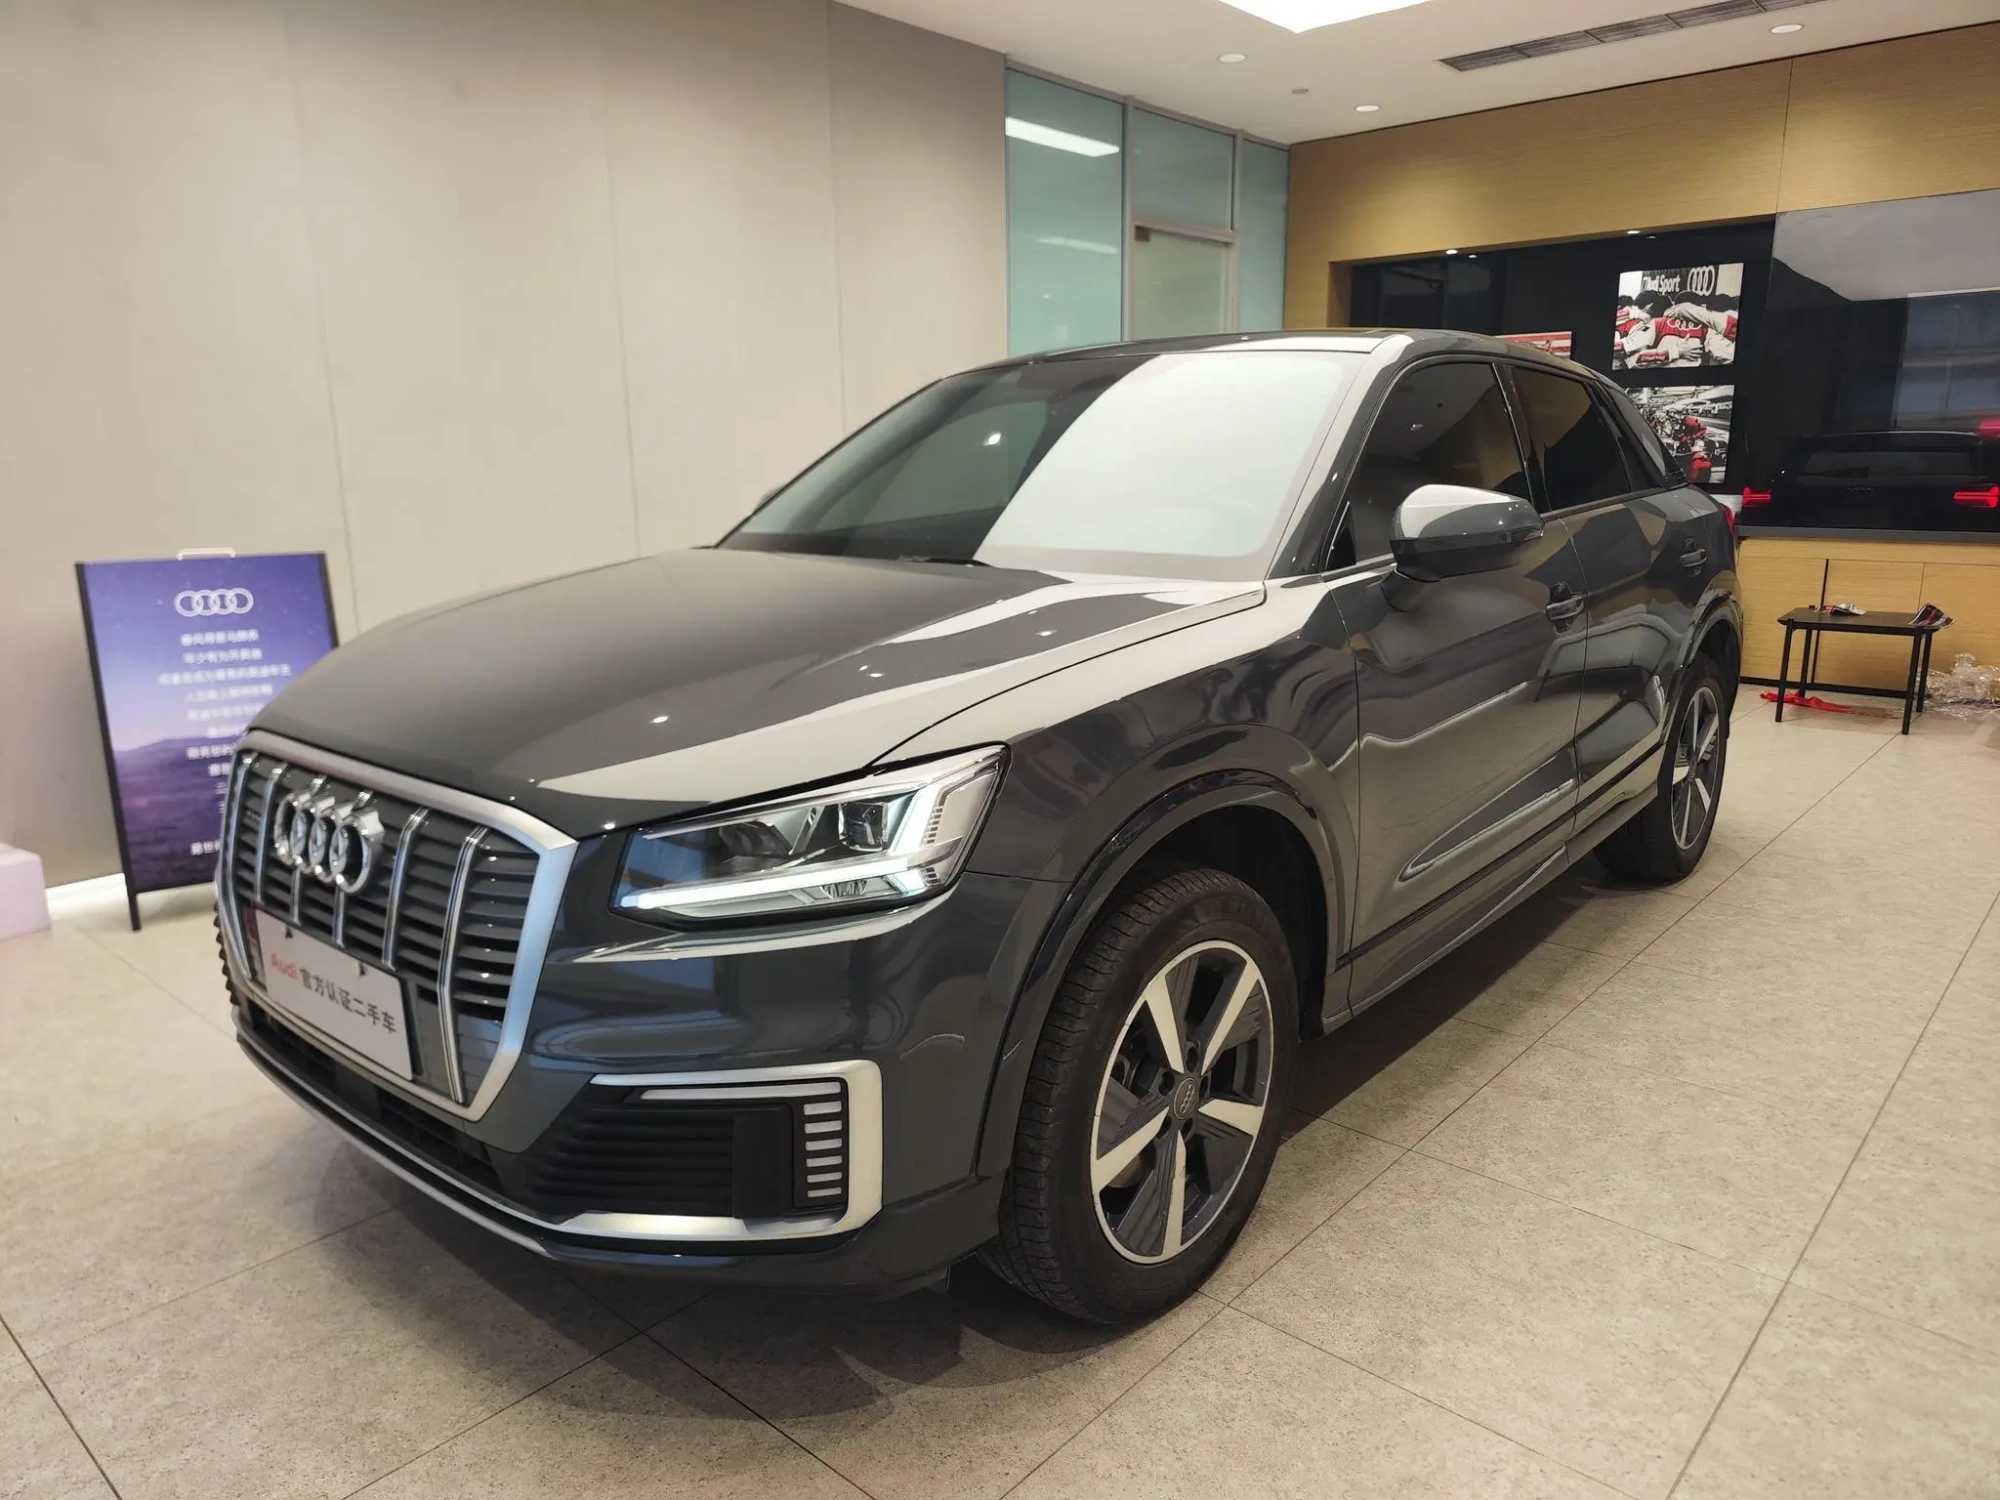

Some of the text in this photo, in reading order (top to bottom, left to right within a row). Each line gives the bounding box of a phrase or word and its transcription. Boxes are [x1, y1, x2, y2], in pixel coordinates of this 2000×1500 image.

[1659, 274, 1681, 295] Sport
[271, 953, 397, 1034] Audi 官方认证二手车
